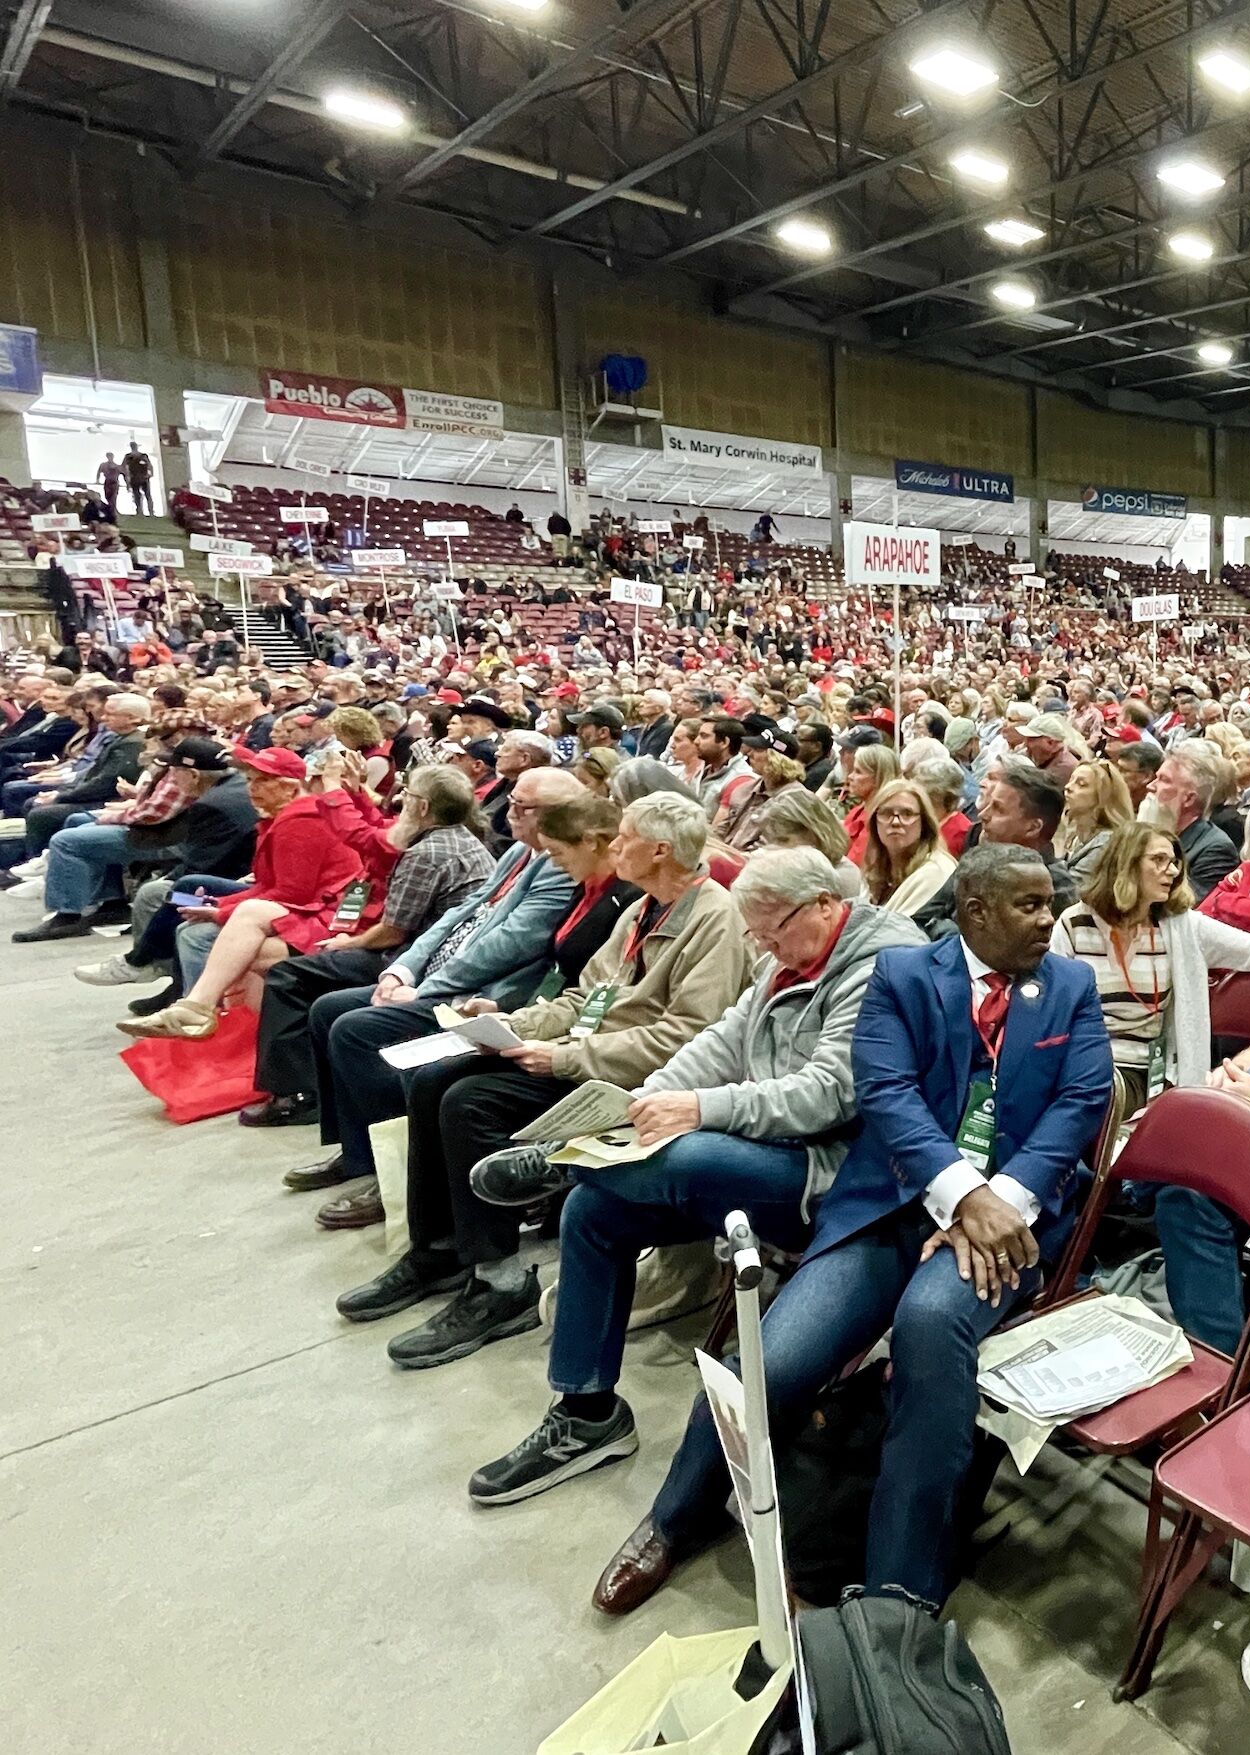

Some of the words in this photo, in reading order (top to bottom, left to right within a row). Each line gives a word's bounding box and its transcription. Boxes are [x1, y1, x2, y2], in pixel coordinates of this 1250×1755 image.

[269, 379, 341, 407] Pueblo
[409, 394, 429, 403] THE
[431, 397, 459, 407] FIRST
[462, 401, 498, 412] CHOICE
[422, 405, 441, 414] FOR
[444, 408, 488, 420] SUCCESS
[668, 436, 686, 450] St.
[690, 440, 721, 457] Mary
[725, 445, 767, 460] Corwin
[770, 451, 816, 468] Hospital
[900, 469, 951, 487] Michelob
[963, 476, 1010, 495] ULTRA
[1102, 493, 1149, 511] pepsi
[208, 541, 234, 552] LAKE
[864, 535, 930, 574] ARAPAHOE
[217, 558, 264, 571] SEDGWICK
[358, 553, 400, 563] MONTROSE
[625, 585, 632, 599] EL
[634, 587, 653, 602] PASO
[1140, 599, 1173, 617] DOUGLAS
